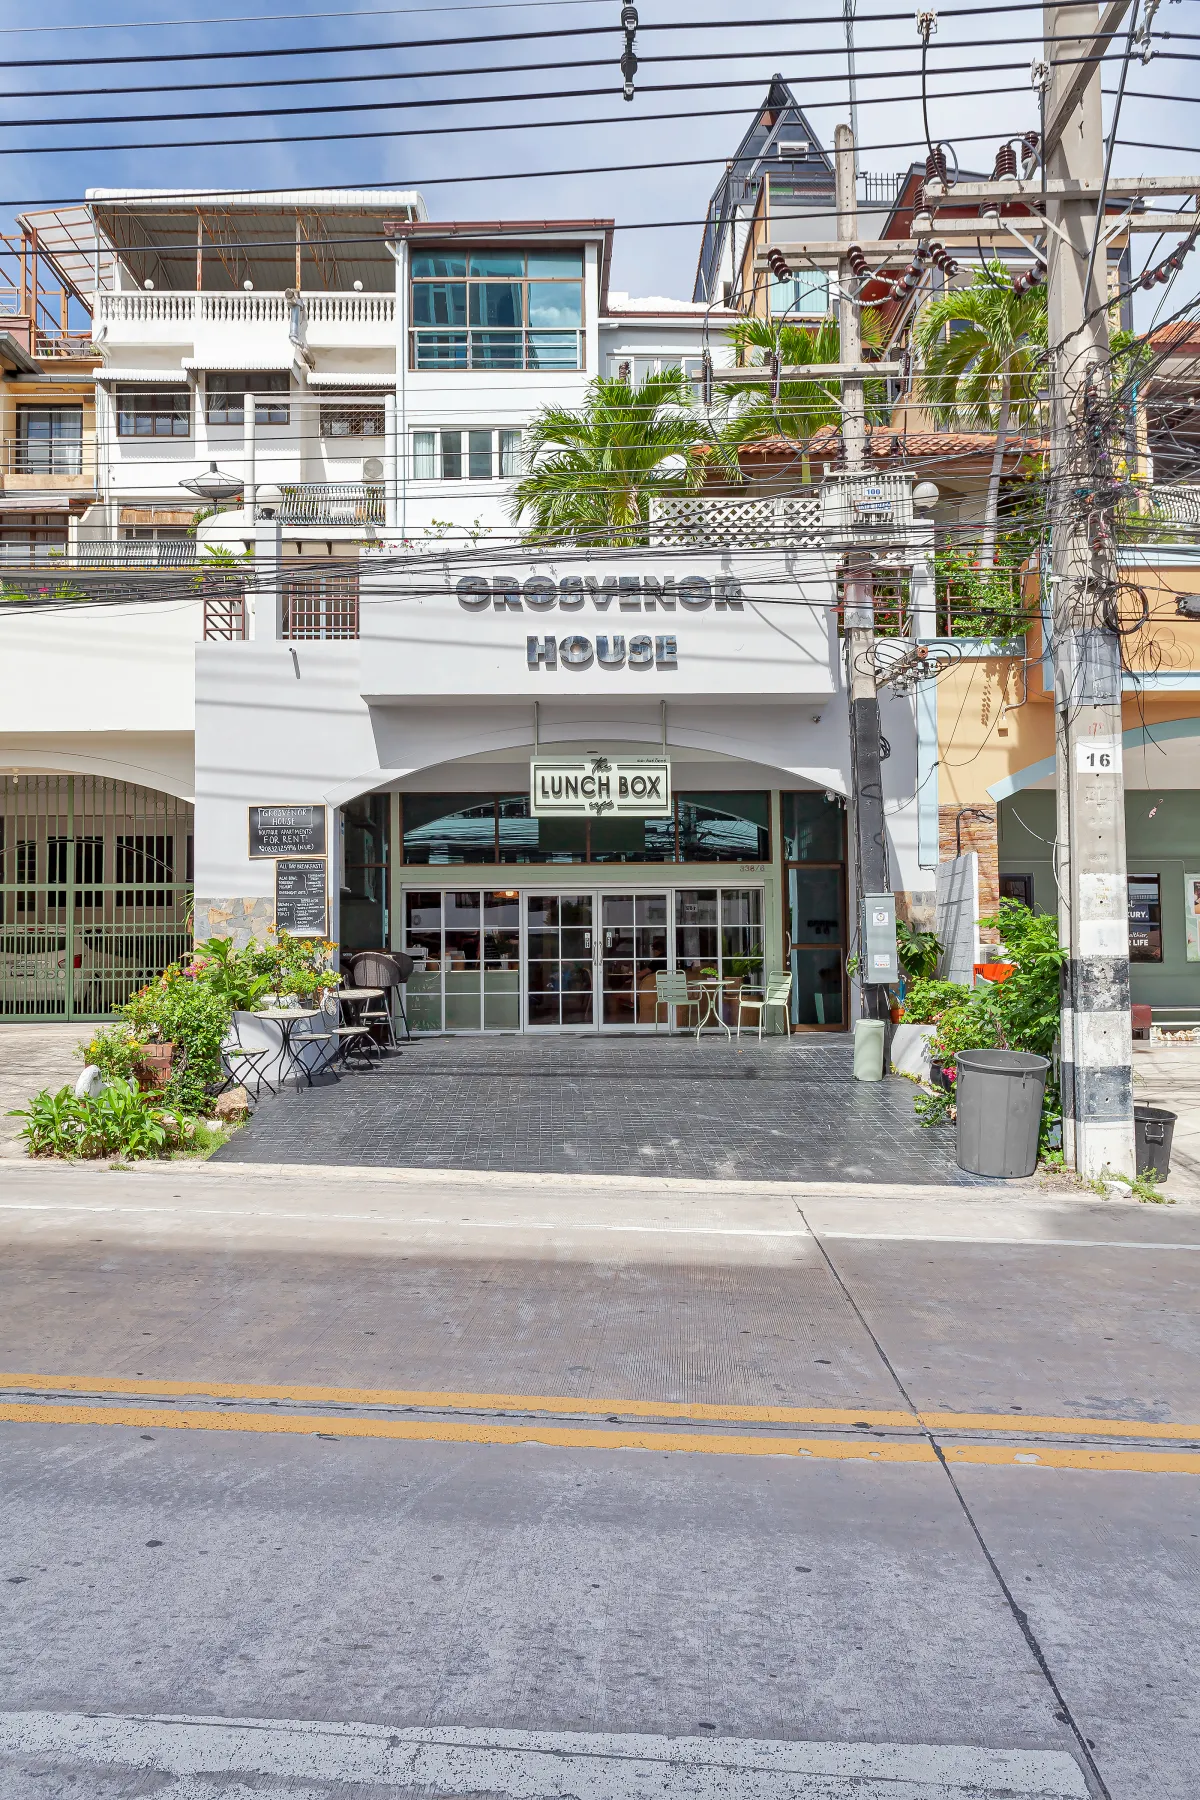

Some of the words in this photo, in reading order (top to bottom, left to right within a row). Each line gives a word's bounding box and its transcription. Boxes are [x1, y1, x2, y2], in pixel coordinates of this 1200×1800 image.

[455, 575, 744, 609] GROSVENOR
[526, 634, 678, 667] HOUSE
[1086, 753, 1110, 767] 16
[541, 775, 611, 798] LUNCH
[618, 775, 661, 798] BOX
[262, 809, 307, 817] GROSVENOR
[272, 817, 296, 826] HOUSE
[263, 835, 280, 844] FOR
[282, 834, 308, 844] RENT!
